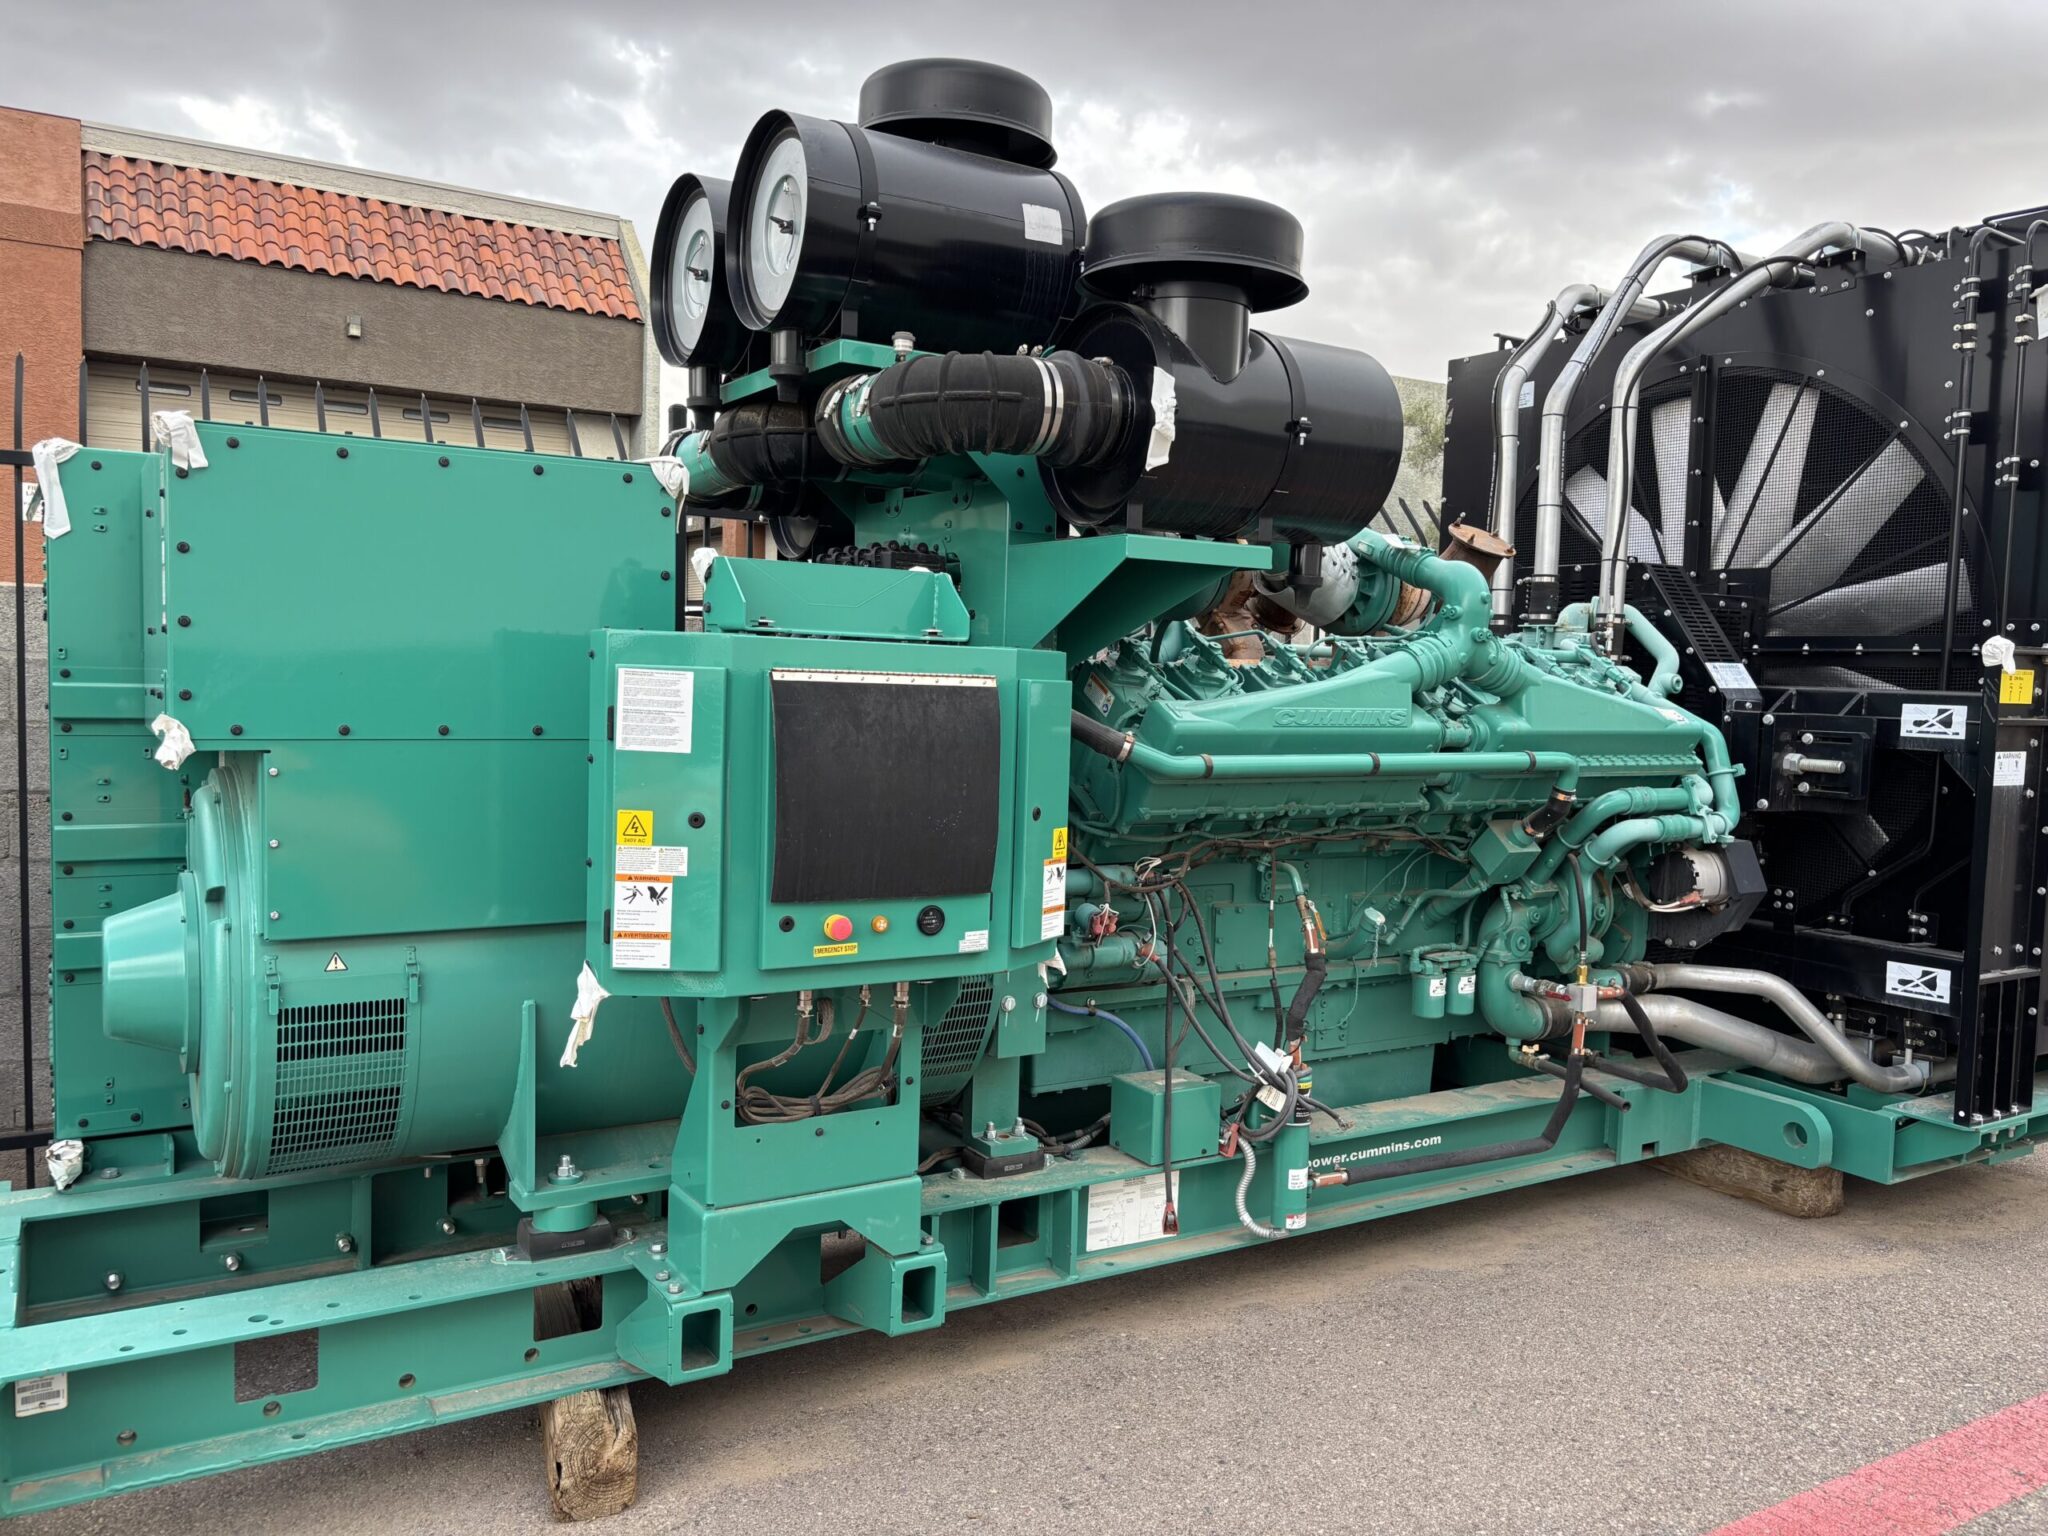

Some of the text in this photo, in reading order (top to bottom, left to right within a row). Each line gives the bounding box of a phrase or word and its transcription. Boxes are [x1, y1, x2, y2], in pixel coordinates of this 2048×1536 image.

[1273, 708, 1408, 727] CUMMINS
[623, 931, 669, 939] AVERTISSEMENT
[814, 944, 857, 955] EMERGENCY STOP
